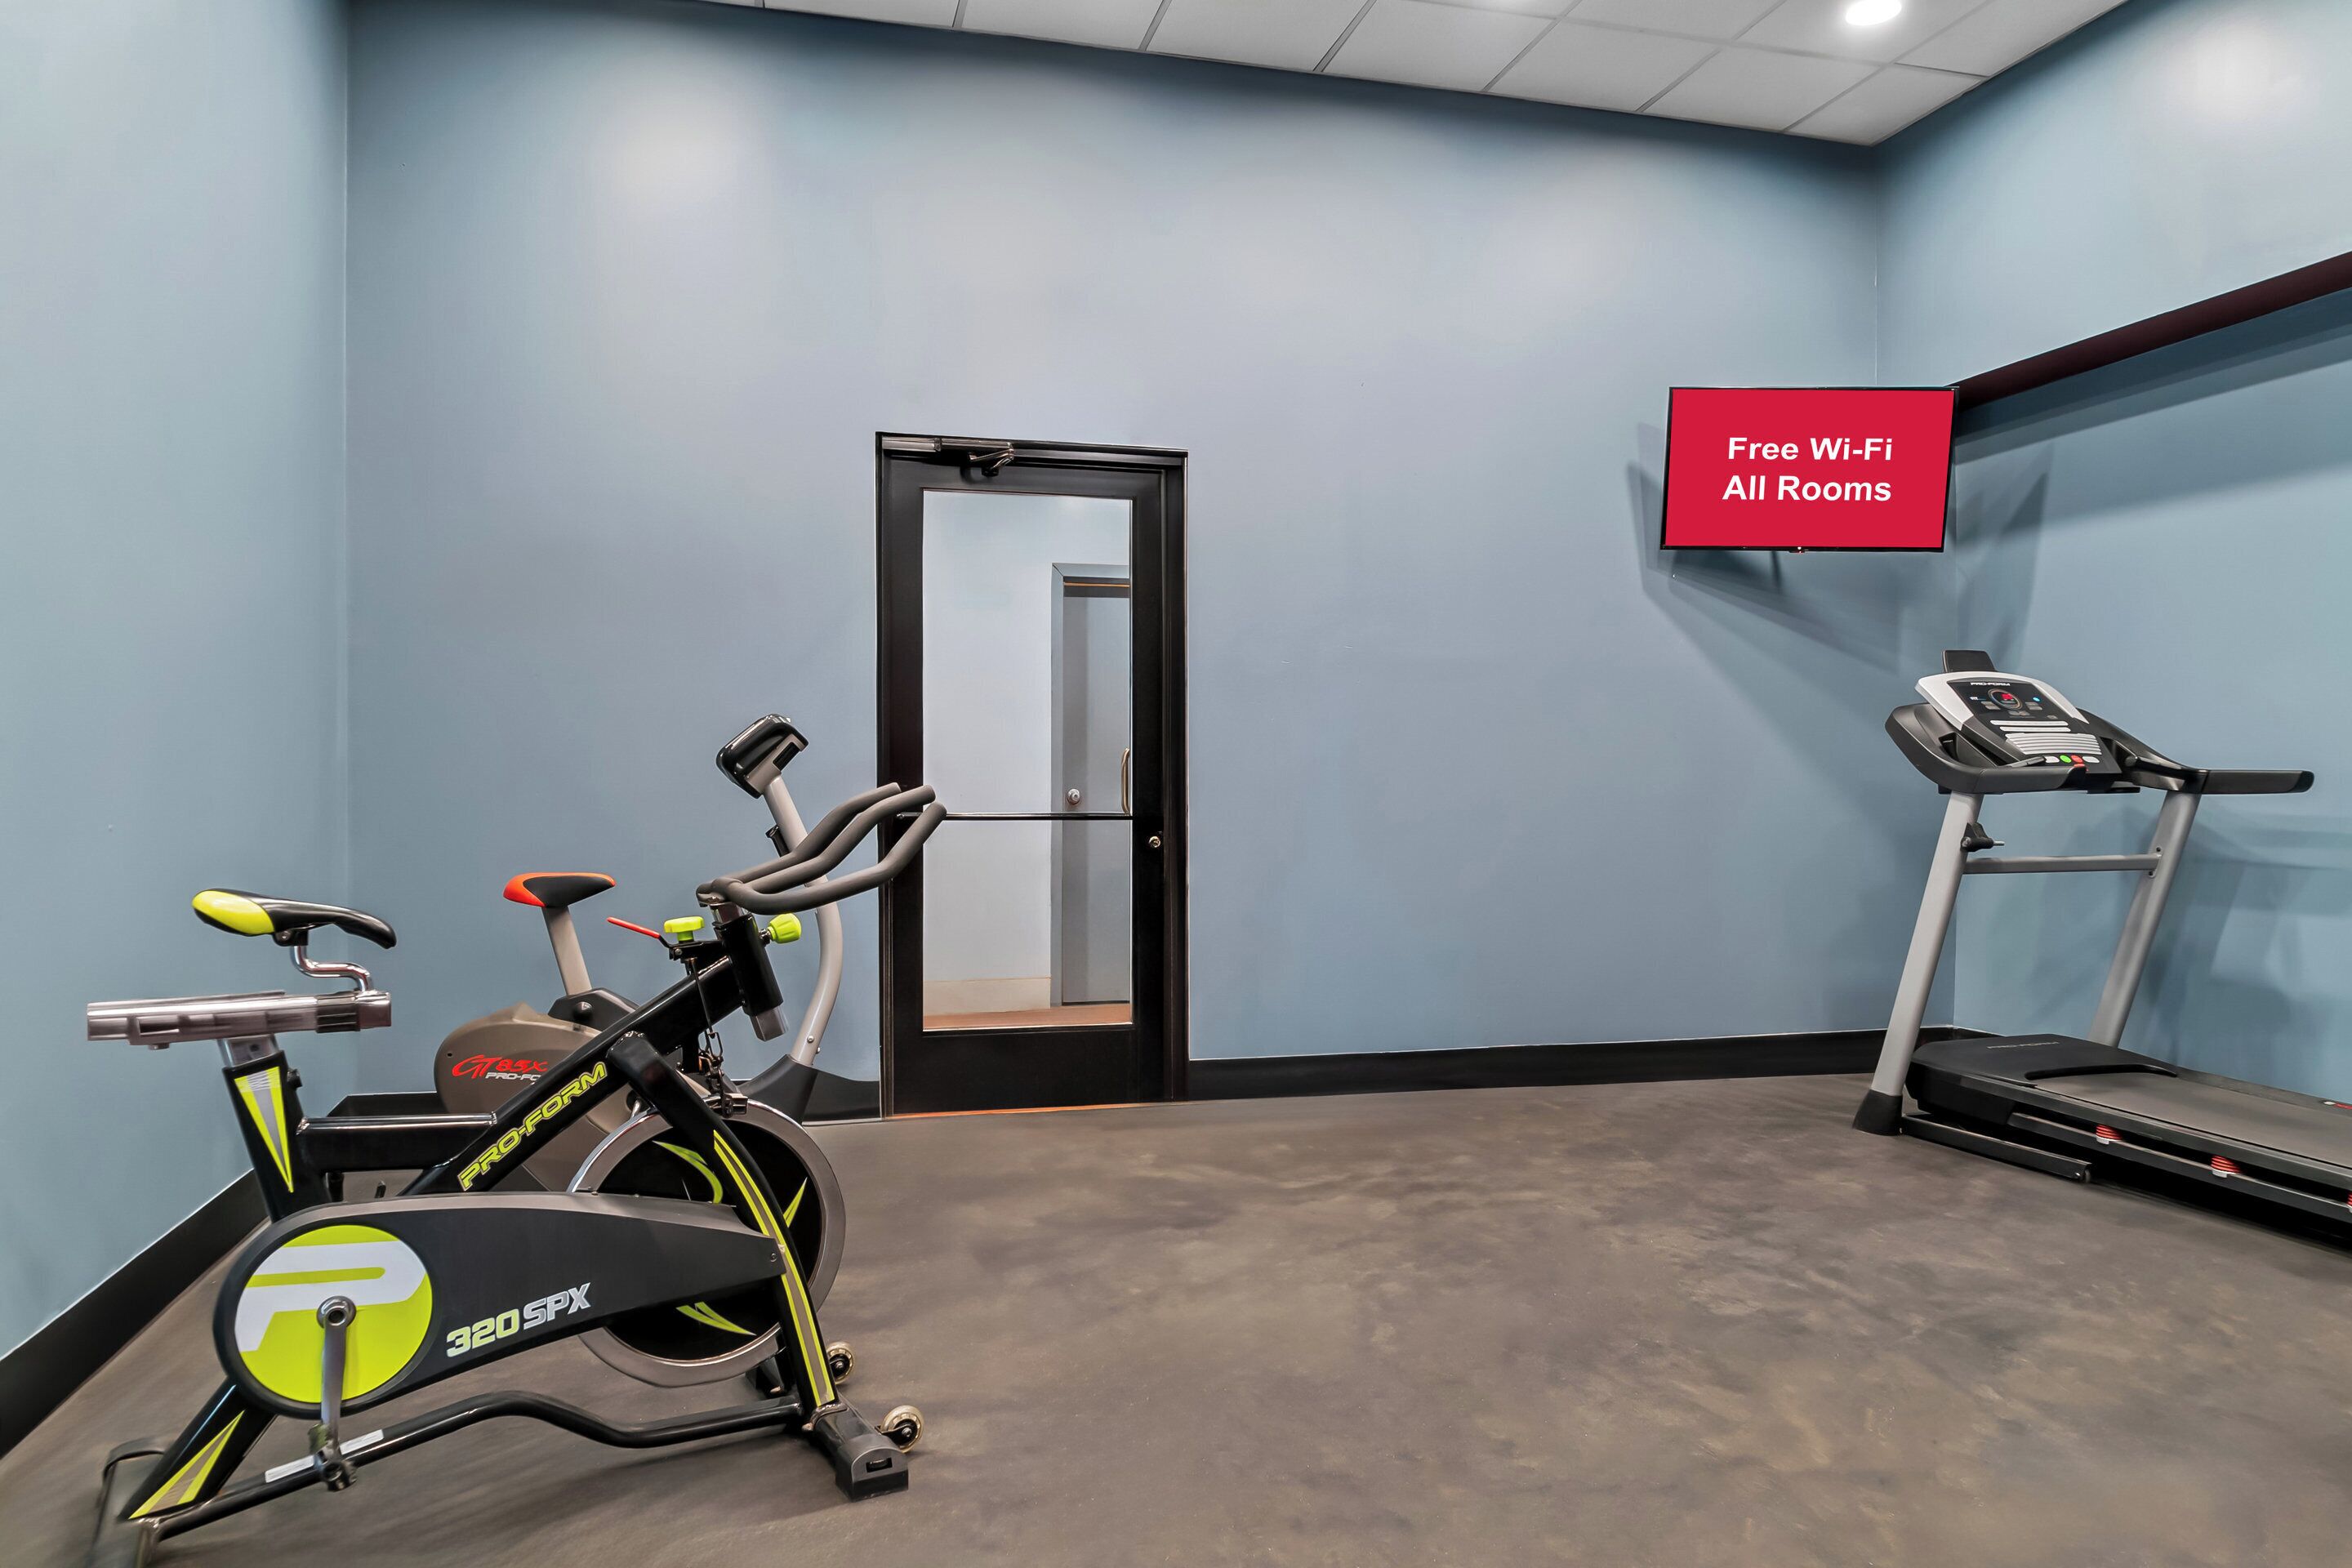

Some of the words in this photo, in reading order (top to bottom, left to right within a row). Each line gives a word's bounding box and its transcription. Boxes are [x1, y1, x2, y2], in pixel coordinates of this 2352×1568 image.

[1728, 437, 1799, 461] Free
[1810, 437, 1893, 461] Wi-Fi
[1722, 475, 1766, 501] All
[1777, 475, 1891, 501] Rooms
[484, 1071, 541, 1081] PRO-FO
[457, 1062, 608, 1192] PRO-FORM
[446, 1308, 520, 1358] 320
[523, 1282, 591, 1330] SPX
